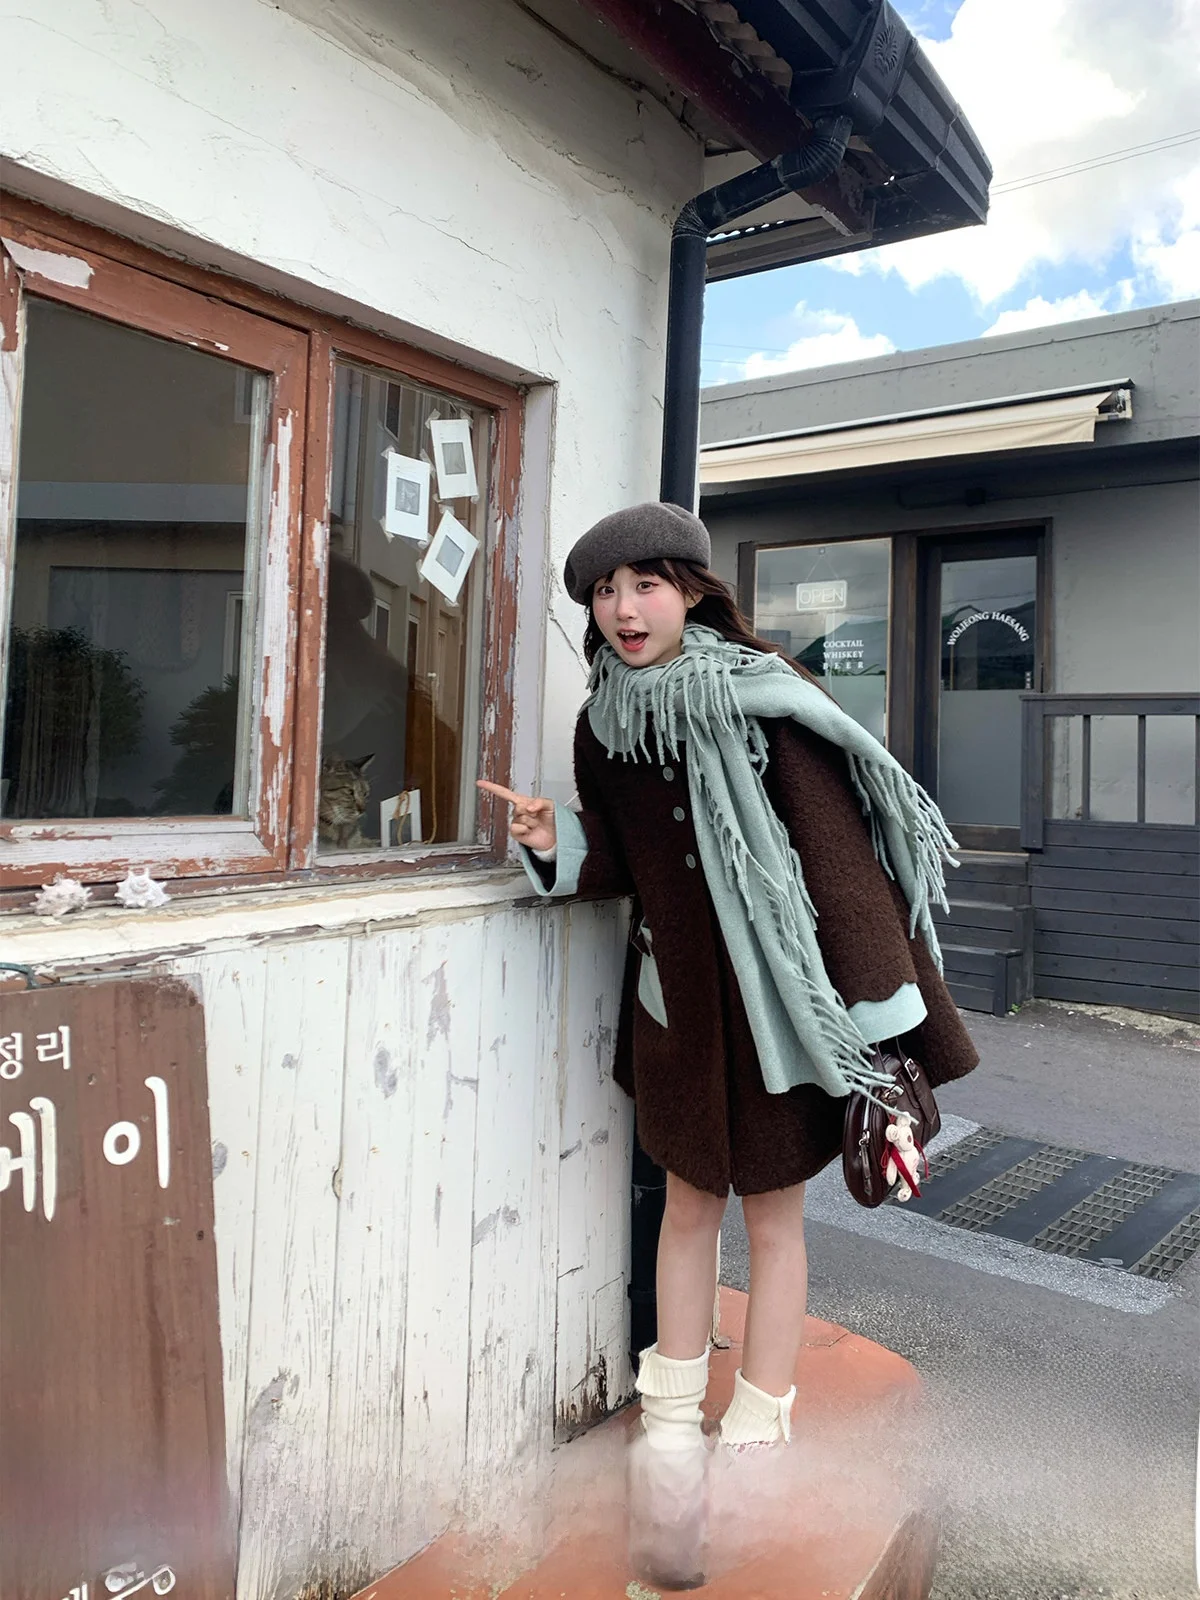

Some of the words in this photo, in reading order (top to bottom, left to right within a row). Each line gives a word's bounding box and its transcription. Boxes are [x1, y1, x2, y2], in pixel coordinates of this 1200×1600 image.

[800, 587, 844, 605] OPEN
[946, 611, 990, 645] WOLJEONG
[991, 611, 1030, 642] HAESANG
[823, 640, 865, 648] COCKTAIL
[823, 650, 864, 659] WHISKEY
[823, 661, 864, 670] BEER
